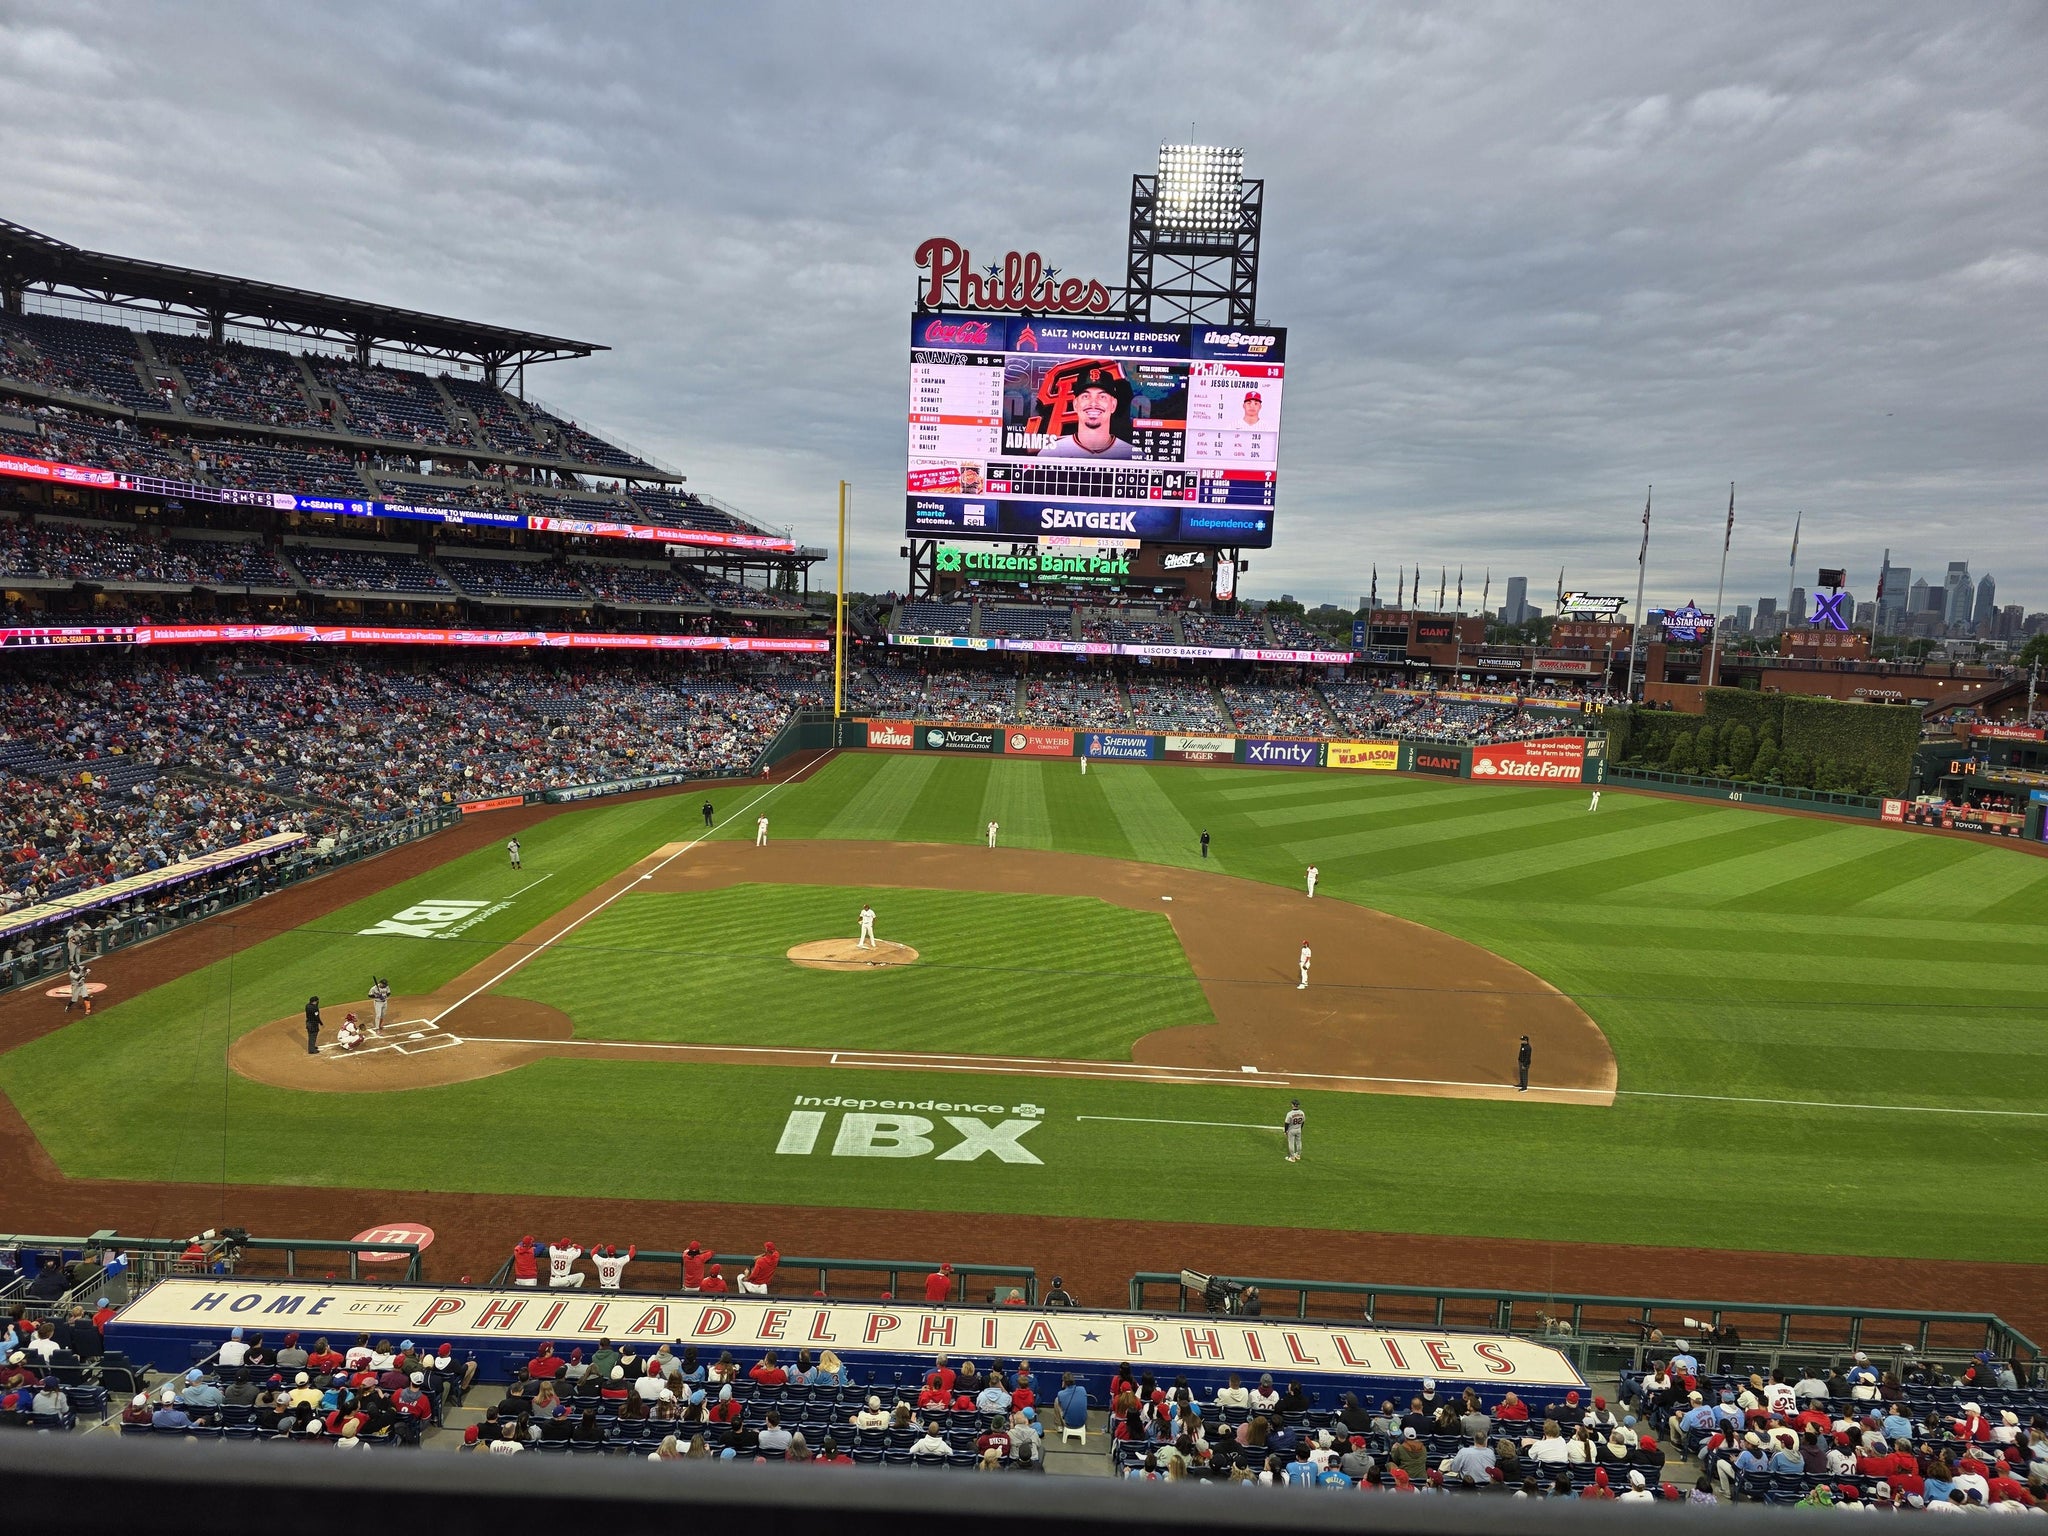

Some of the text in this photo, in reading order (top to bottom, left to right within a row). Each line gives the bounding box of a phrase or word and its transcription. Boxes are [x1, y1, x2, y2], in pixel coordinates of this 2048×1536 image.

[914, 237, 1111, 313] Phillies
[1041, 328, 1181, 342] SALTZ MONGELUZZI BENDESKY
[1203, 331, 1276, 346] theScore
[1067, 342, 1153, 353] INJURY LAWYERS
[1190, 362, 1240, 378] Phillies
[1006, 425, 1027, 433] WILLY
[1005, 433, 1058, 450] ADAMES
[24, 463, 50, 475] Pastime
[993, 470, 1004, 478] SF
[1202, 470, 1224, 479] DUE UP
[990, 482, 1006, 492] PHI
[301, 500, 364, 512] 4-SEAM FB 98
[916, 502, 944, 511] Driving
[384, 504, 414, 514] SPECIAL
[414, 506, 448, 516] WELCOME
[459, 511, 493, 520] WEGMANS
[494, 514, 519, 522] BAKERY
[916, 510, 946, 518] smarter
[916, 518, 955, 526] outcomes.
[1041, 508, 1136, 532] SEATGEEK
[1190, 518, 1254, 530] Independence
[965, 551, 1130, 574] Citizens Bank Park
[1164, 552, 1198, 570] GHOST
[1566, 592, 1620, 606] Fitzpatrick
[1809, 593, 1849, 630] X
[1662, 616, 1714, 627] ALL STAR GAME
[352, 630, 444, 641] Drink in America's Pastime
[1420, 628, 1450, 637] GIANT
[30, 634, 91, 644] 13 FOUR-SEAM FB
[900, 636, 919, 644] UKG
[934, 636, 954, 646] UKG
[968, 638, 988, 648] UKG
[1036, 642, 1060, 650] NECA
[1088, 645, 1110, 654] NECA
[1144, 647, 1214, 656] LISCIO'S BAKERY
[1259, 652, 1294, 660] TOYOTA
[1314, 652, 1348, 662] TOYOTA
[1586, 702, 1604, 714] 0:14
[870, 730, 912, 746] Wawa
[946, 731, 992, 743] NovaCare
[1047, 738, 1070, 746] WEBB
[1103, 735, 1147, 747] SHERWIN
[1178, 738, 1222, 751] Yuengling
[1102, 745, 1148, 757] WILLIAMS.
[1185, 752, 1213, 760] LAGER
[1250, 742, 1312, 763] xfinity
[1417, 755, 1460, 770] GIANT
[1951, 761, 1976, 774] 0:14
[1728, 792, 1743, 801] 401
[1955, 822, 1982, 830] TOYOTA
[794, 1095, 1004, 1114] Independence
[775, 1110, 1044, 1165] IBX
[554, 1260, 566, 1270] 38
[603, 1267, 615, 1277] 88
[190, 1292, 1516, 1376] HOME OF THE PHILADELPHIA PHILLIES
[1782, 1398, 1795, 1410] 25
[1700, 1417, 1714, 1429] 20
[1301, 1472, 1311, 1488] 11
